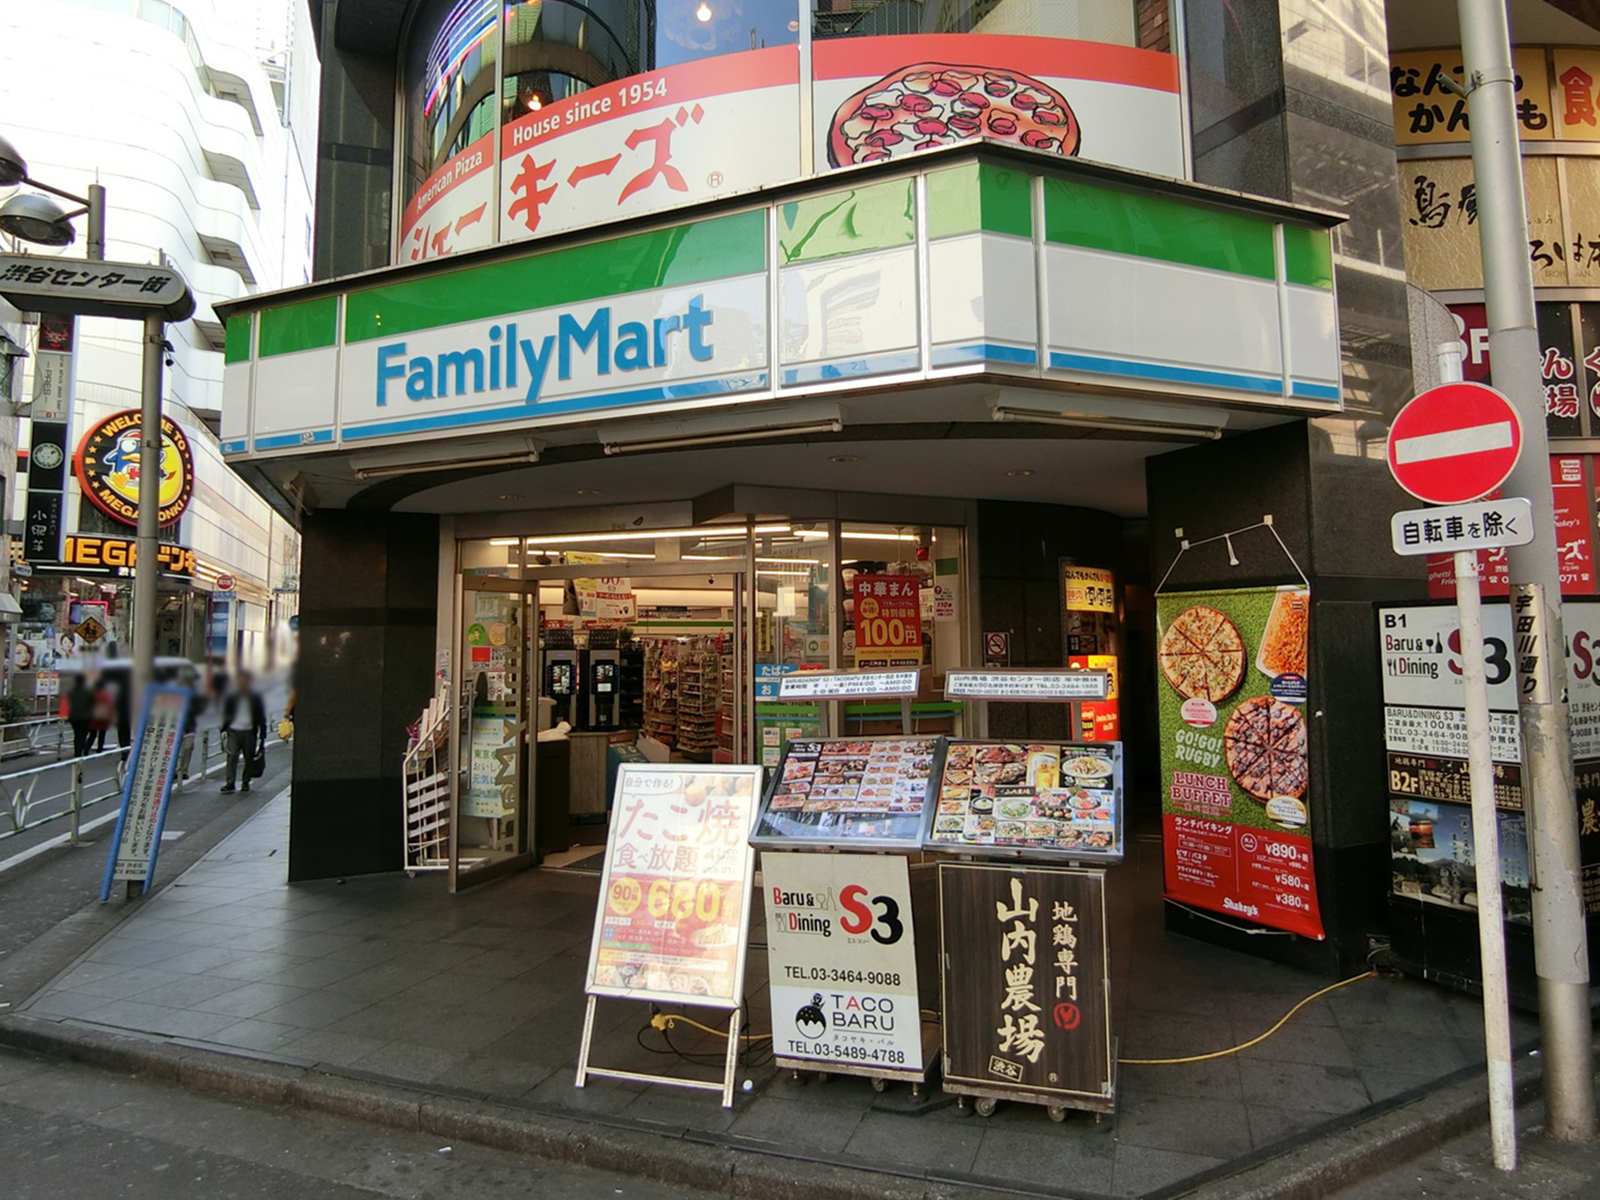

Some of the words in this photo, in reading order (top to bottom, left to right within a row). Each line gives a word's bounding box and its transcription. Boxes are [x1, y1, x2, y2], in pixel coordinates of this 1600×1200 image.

[1559, 65, 1600, 128] 食
[416, 170, 453, 214] American
[455, 150, 483, 179] Pizza
[513, 115, 560, 146] House
[565, 96, 611, 125] since
[618, 77, 668, 108] 1954
[1, 263, 172, 294] 渋谷センター街
[375, 294, 714, 408] FamilyMart
[174, 431, 186, 451] TO
[158, 499, 185, 522] ONKI
[1403, 511, 1519, 545] 自転車を除く
[859, 581, 914, 597] 中華まん
[860, 618, 905, 646] 100
[1384, 613, 1408, 630] B1
[1515, 594, 1539, 695] 宇田川通り
[1398, 657, 1439, 680] Dining
[1386, 707, 1440, 721] BARU&DINING
[1443, 711, 1454, 721] S3
[1175, 729, 1224, 751] GO!GO!
[1174, 744, 1221, 769] RUGBY
[625, 776, 674, 789] 自分で作る!
[1174, 772, 1227, 790] LUNCH
[1390, 770, 1419, 793] B2F
[1171, 787, 1231, 807] BUFFET
[618, 799, 742, 846] たこ焼
[1174, 816, 1233, 835] ランチバイキング
[613, 842, 699, 874] 食べ放題
[647, 878, 722, 921] 680
[772, 886, 815, 907] Baru&
[1222, 896, 1259, 917] Shakey's
[789, 912, 832, 938] Dining
[839, 884, 904, 945] S3
[1052, 900, 1079, 1001] 地鶏専門
[784, 965, 901, 987] TEL.03-3464-9088
[996, 877, 1046, 1064] 山内農場
[831, 994, 894, 1013] TACO
[832, 1011, 895, 1032] BARU
[788, 1039, 905, 1064] TEL.03-5489-4788
[993, 1060, 1019, 1078] 渋谷
